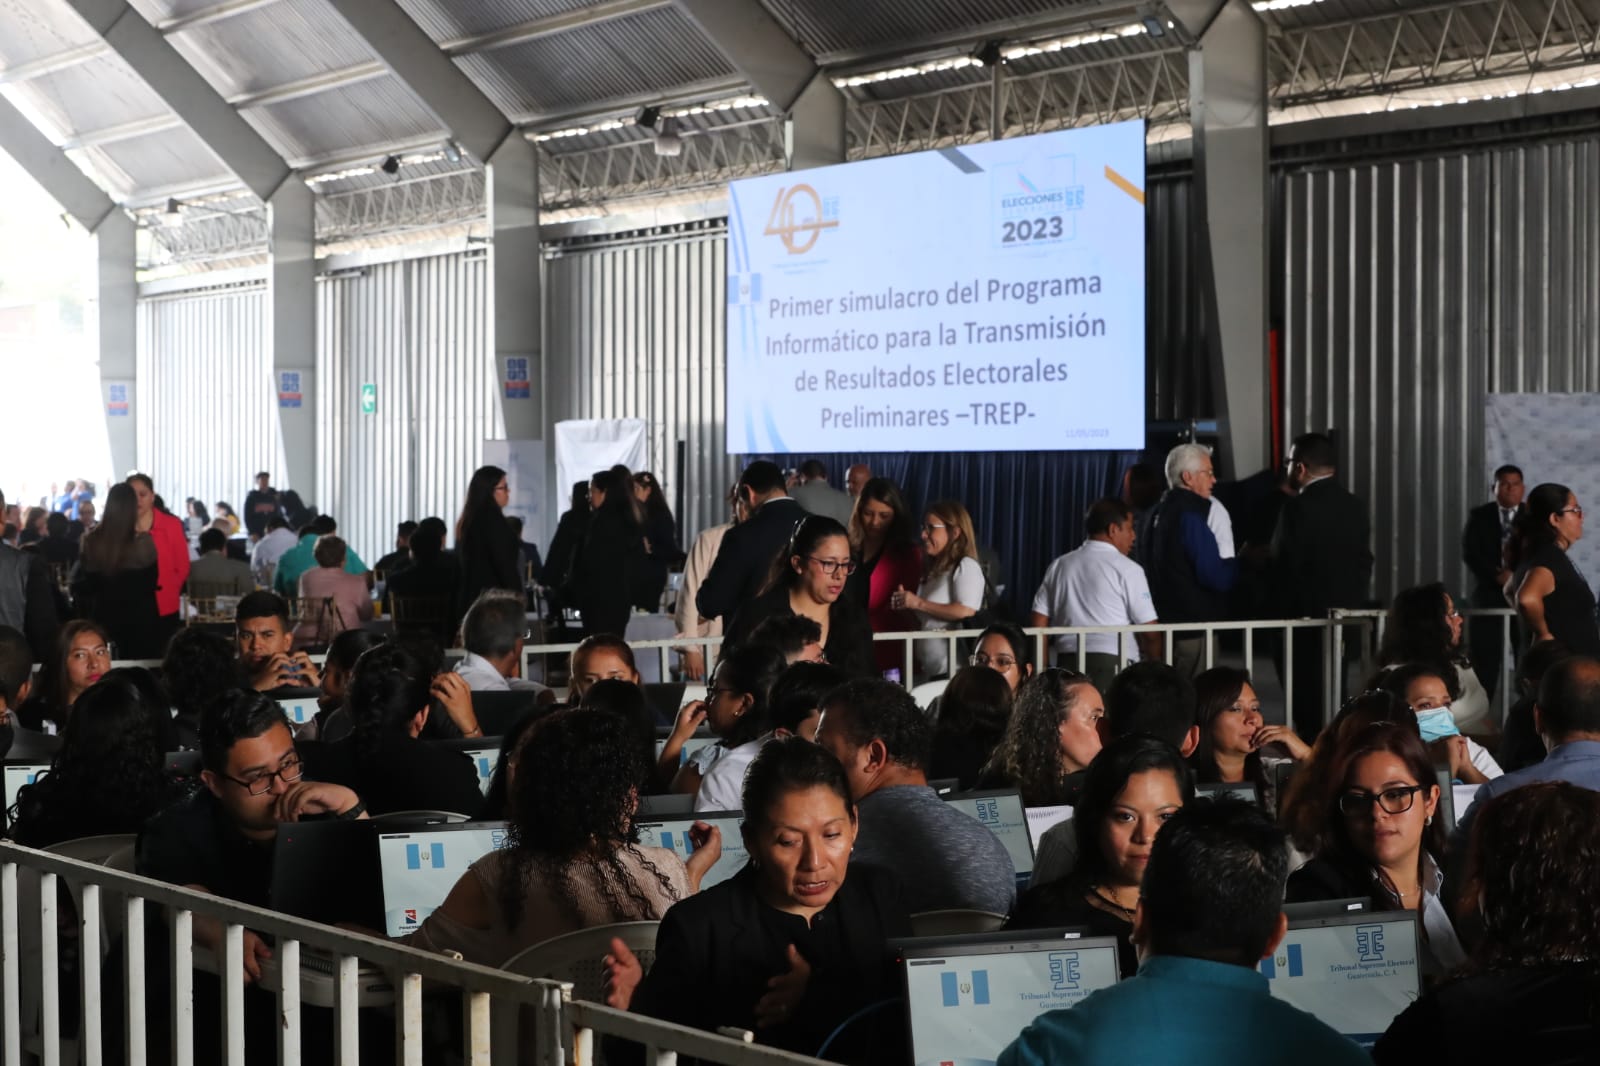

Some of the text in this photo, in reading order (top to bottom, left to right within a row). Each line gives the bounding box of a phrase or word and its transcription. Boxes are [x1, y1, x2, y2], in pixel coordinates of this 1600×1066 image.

[1001, 192, 1064, 208] ELECCIONES
[1002, 215, 1063, 243] 2023
[769, 274, 1102, 319] Primer simulacro del Programa
[766, 312, 1106, 356] Informático para la Transmisión
[794, 358, 1068, 392] de Resultados Electorales
[821, 404, 949, 429] Preliminares
[1020, 992, 1050, 1001] Tribunal
